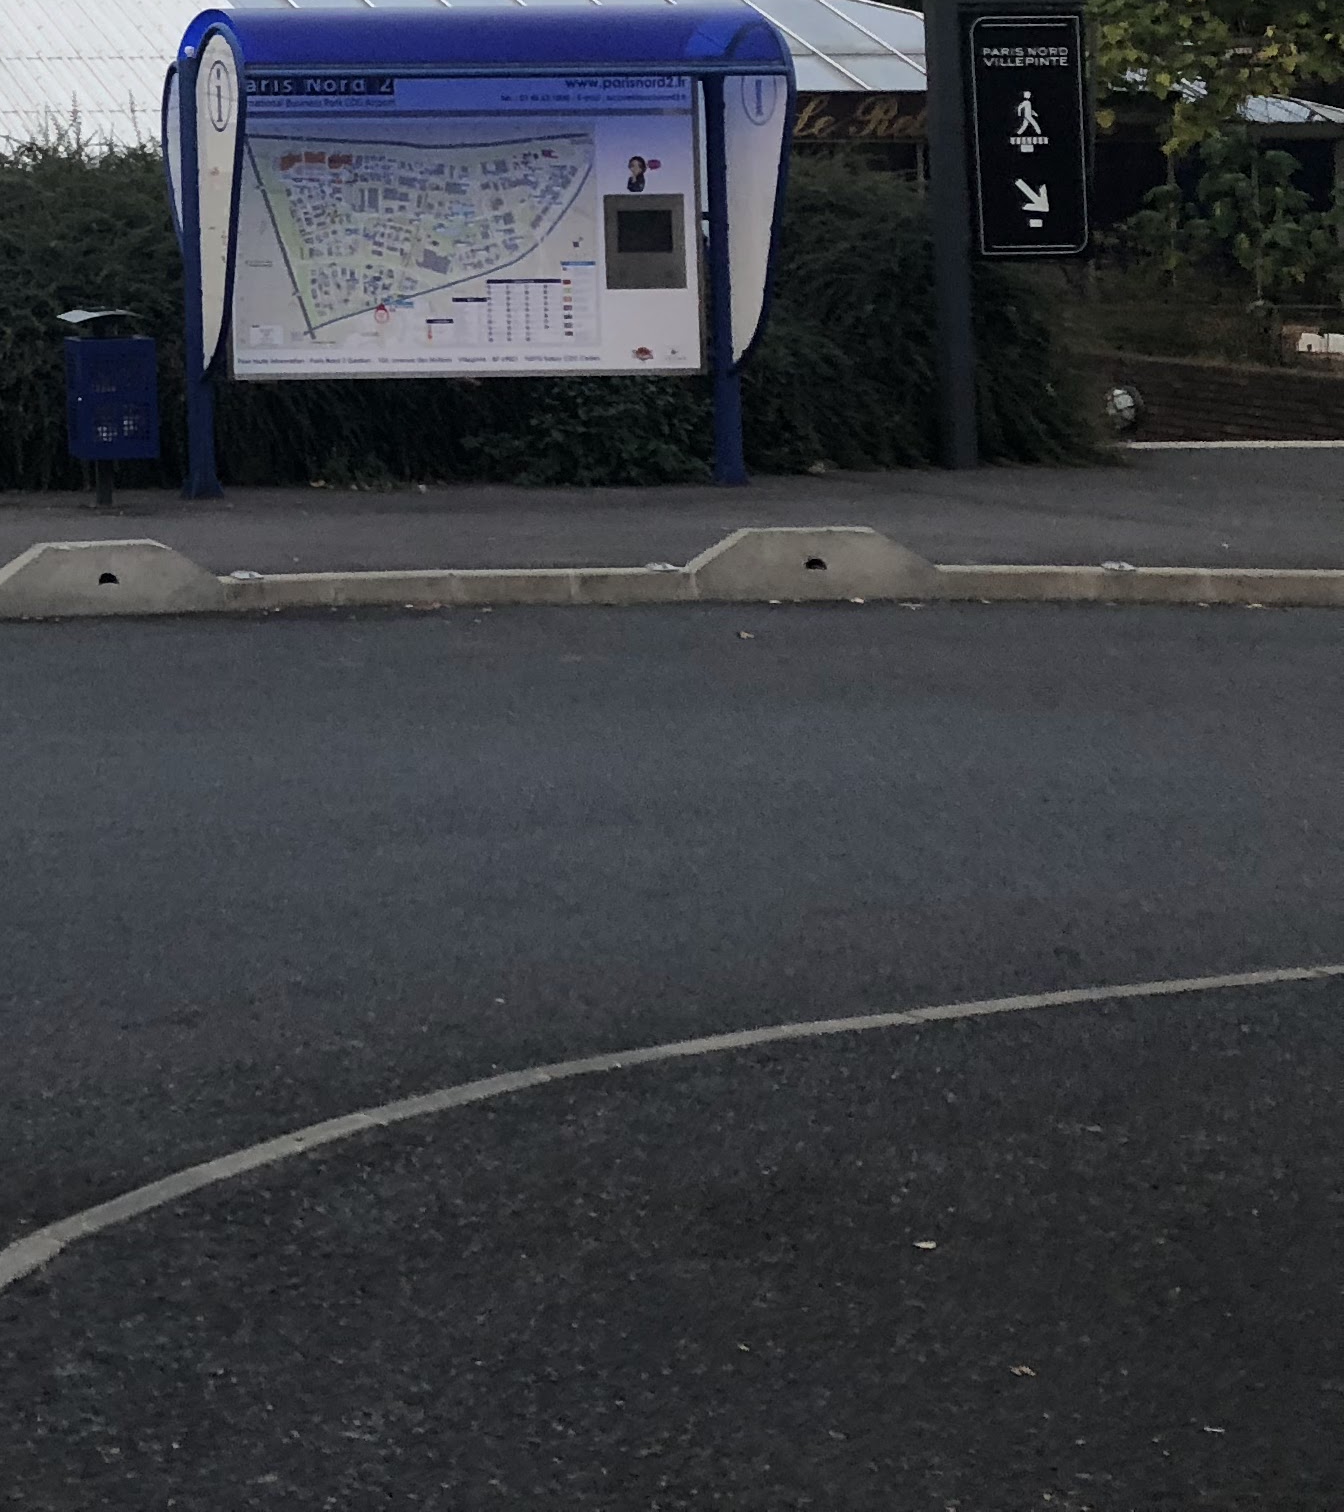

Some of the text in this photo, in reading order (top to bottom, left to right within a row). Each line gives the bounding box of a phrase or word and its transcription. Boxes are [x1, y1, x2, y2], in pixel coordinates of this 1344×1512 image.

[982, 47, 1069, 56] PARIS NORD
[983, 57, 1069, 66] VILLEPINTE
[246, 79, 293, 92] aris
